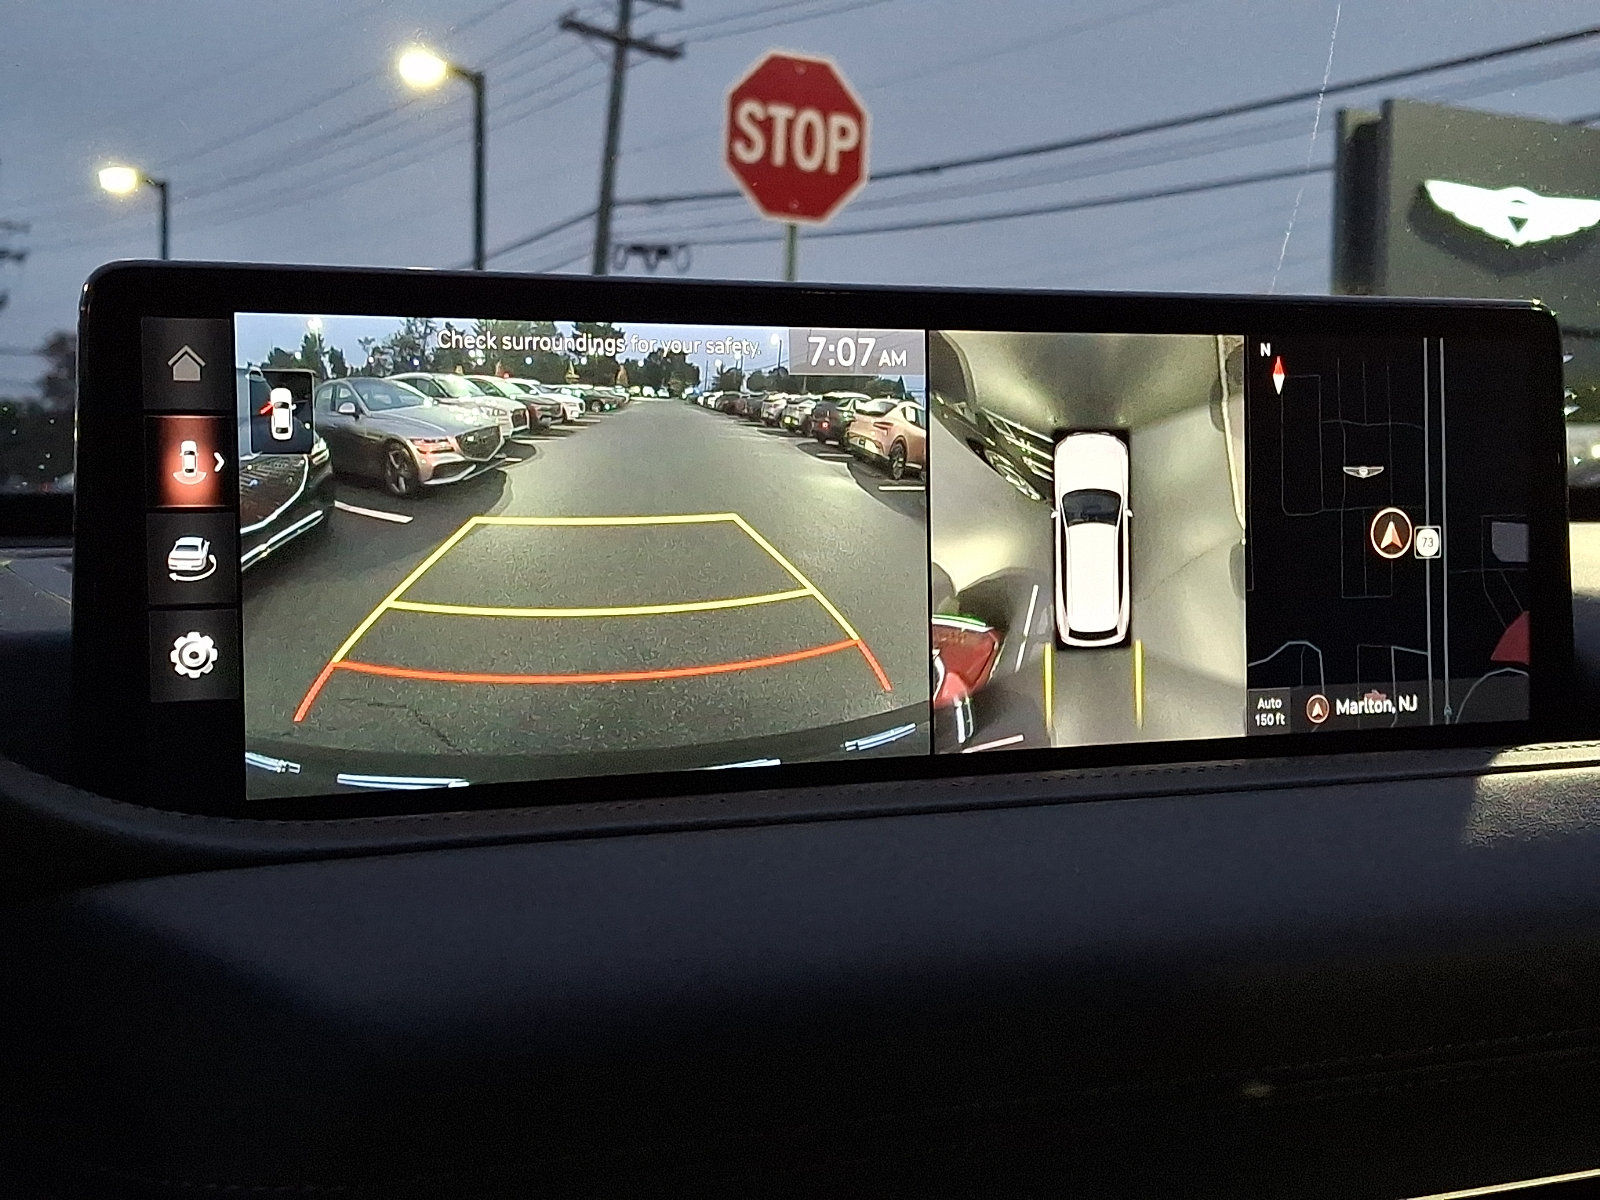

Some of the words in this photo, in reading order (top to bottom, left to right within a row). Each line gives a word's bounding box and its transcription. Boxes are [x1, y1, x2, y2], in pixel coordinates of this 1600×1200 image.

[733, 100, 861, 175] STOP
[437, 329, 498, 350] Check
[501, 332, 626, 357] surroundings
[630, 334, 657, 352] for
[661, 338, 702, 357] your
[705, 336, 762, 356] safety.
[808, 336, 877, 367] 7:07
[878, 349, 907, 367] AM
[1260, 342, 1271, 357] N
[1422, 537, 1434, 548] 73
[1257, 698, 1283, 710] Auto
[1335, 697, 1397, 716] Marlton,
[1398, 694, 1418, 713] NJ
[1255, 713, 1275, 727] 150
[1275, 713, 1286, 726] ft
